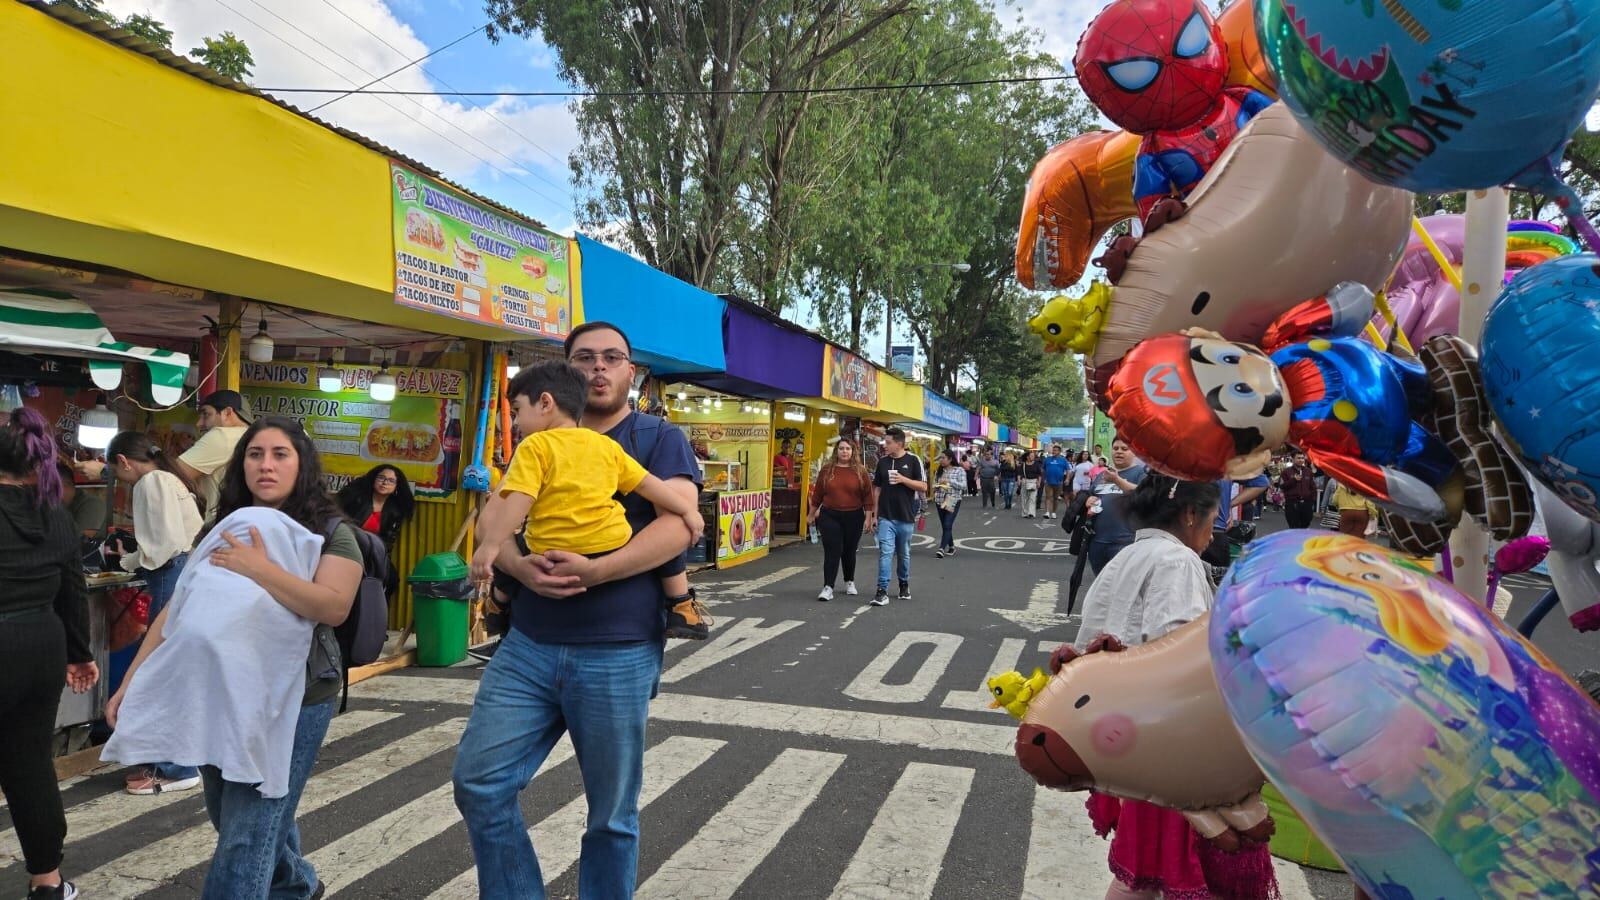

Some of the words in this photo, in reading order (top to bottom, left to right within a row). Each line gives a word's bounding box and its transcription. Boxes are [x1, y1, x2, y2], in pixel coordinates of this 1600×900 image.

[423, 186, 496, 232] BIENVENIDOS
[429, 262, 439, 274] AL
[440, 265, 469, 283] PASTOR
[429, 278, 440, 291] DE
[441, 283, 455, 294] RES
[429, 295, 460, 311] MIXTOS
[252, 396, 272, 413] AL
[278, 397, 339, 417] PASTOR
